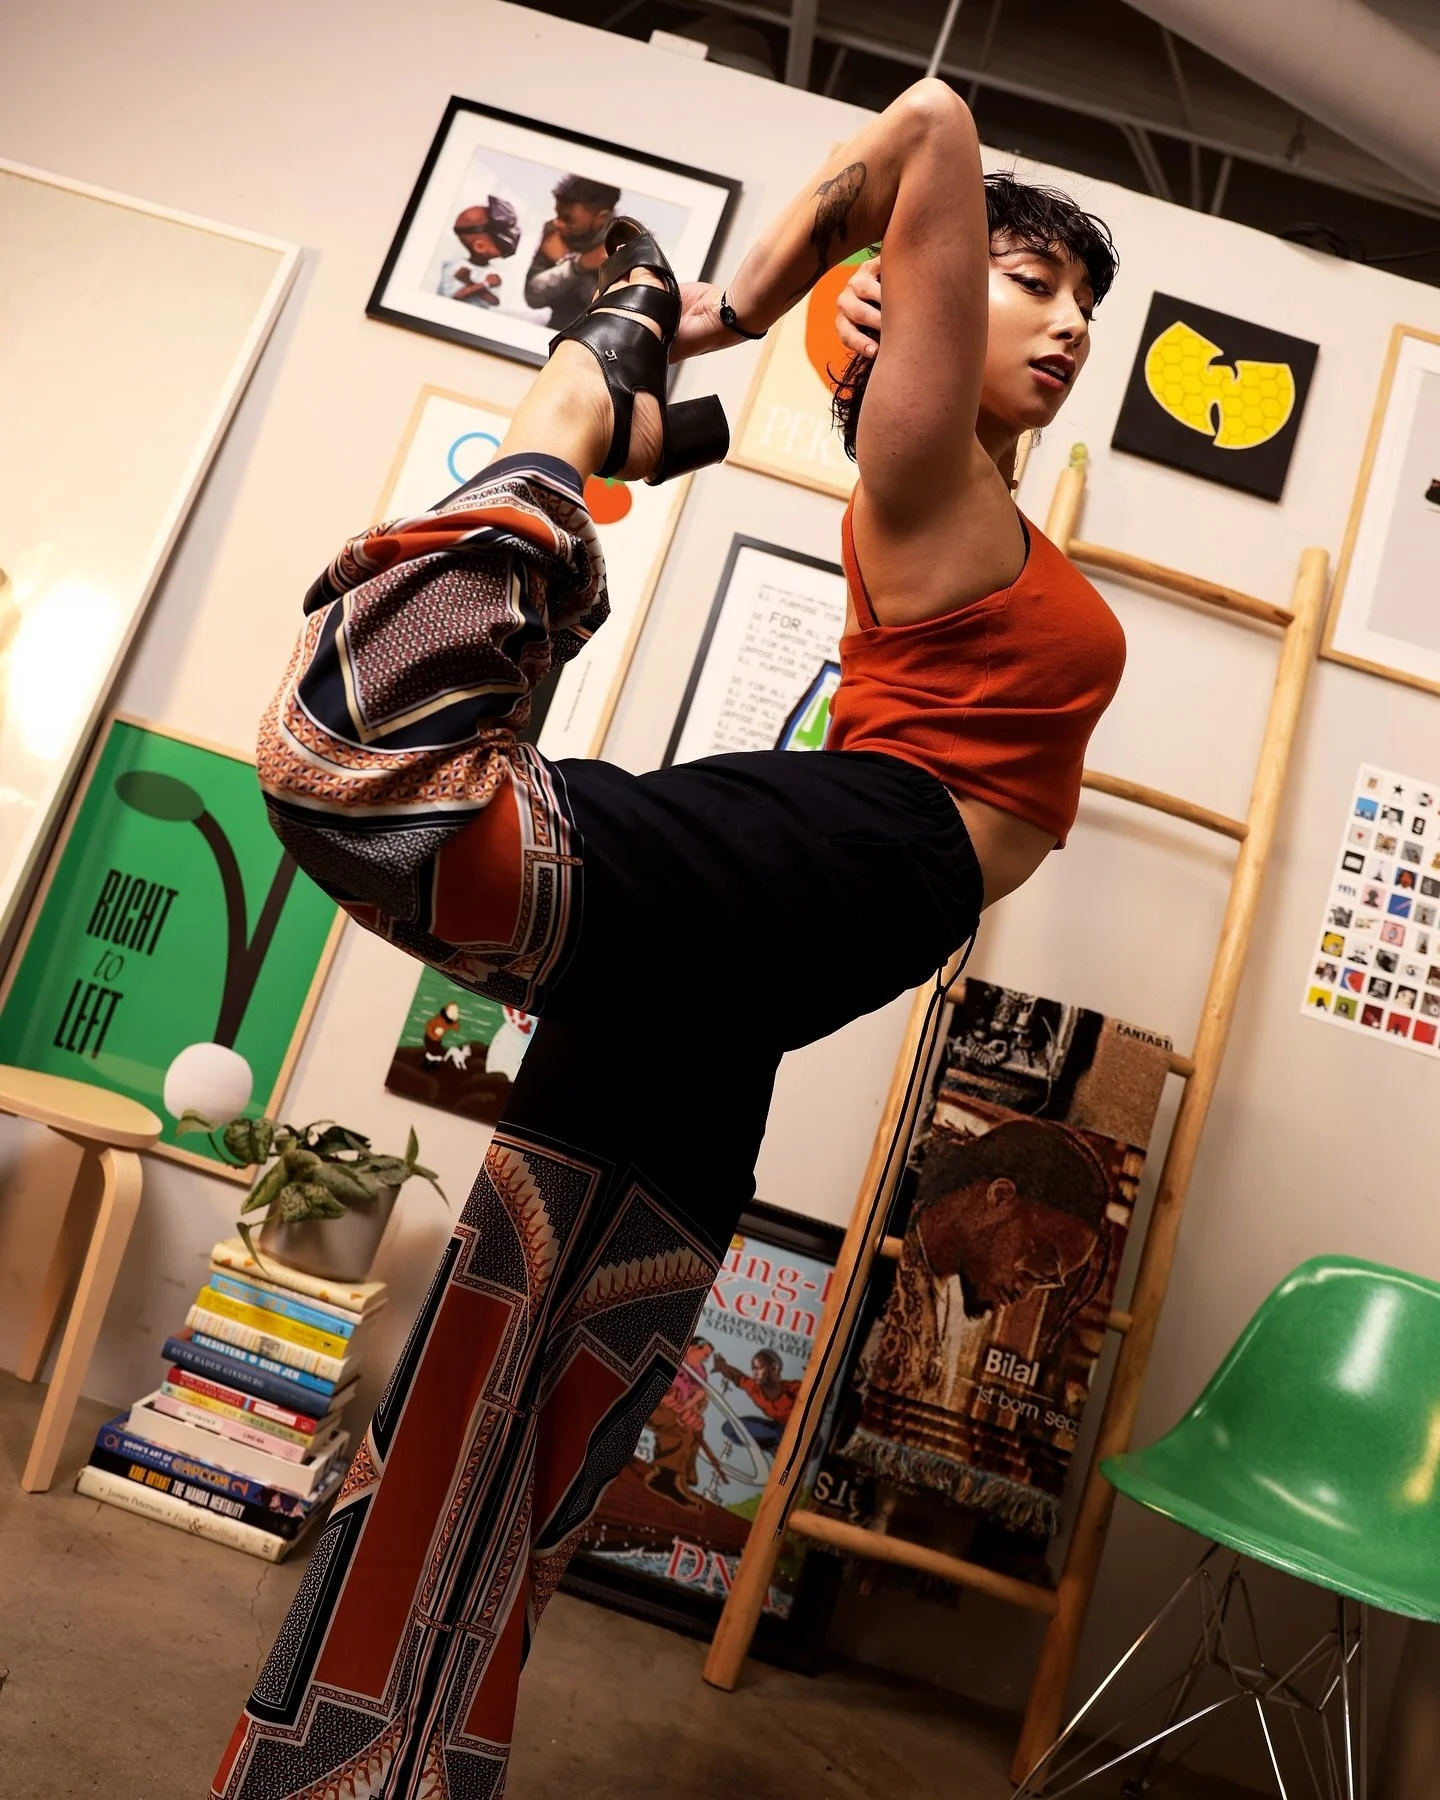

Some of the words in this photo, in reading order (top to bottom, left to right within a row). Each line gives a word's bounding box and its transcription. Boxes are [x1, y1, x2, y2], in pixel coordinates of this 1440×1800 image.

[768, 610, 802, 632] FOR
[86, 868, 179, 956] RIGHT
[92, 947, 125, 982] to
[52, 979, 124, 1059] LEFT
[704, 1318, 743, 1338] STAYS
[745, 1331, 766, 1346] ON
[717, 1310, 777, 1338] HAPPENS
[985, 1348, 1040, 1387] Bilal
[998, 1391, 1040, 1420] born
[169, 1459, 231, 1490] CAPCOM
